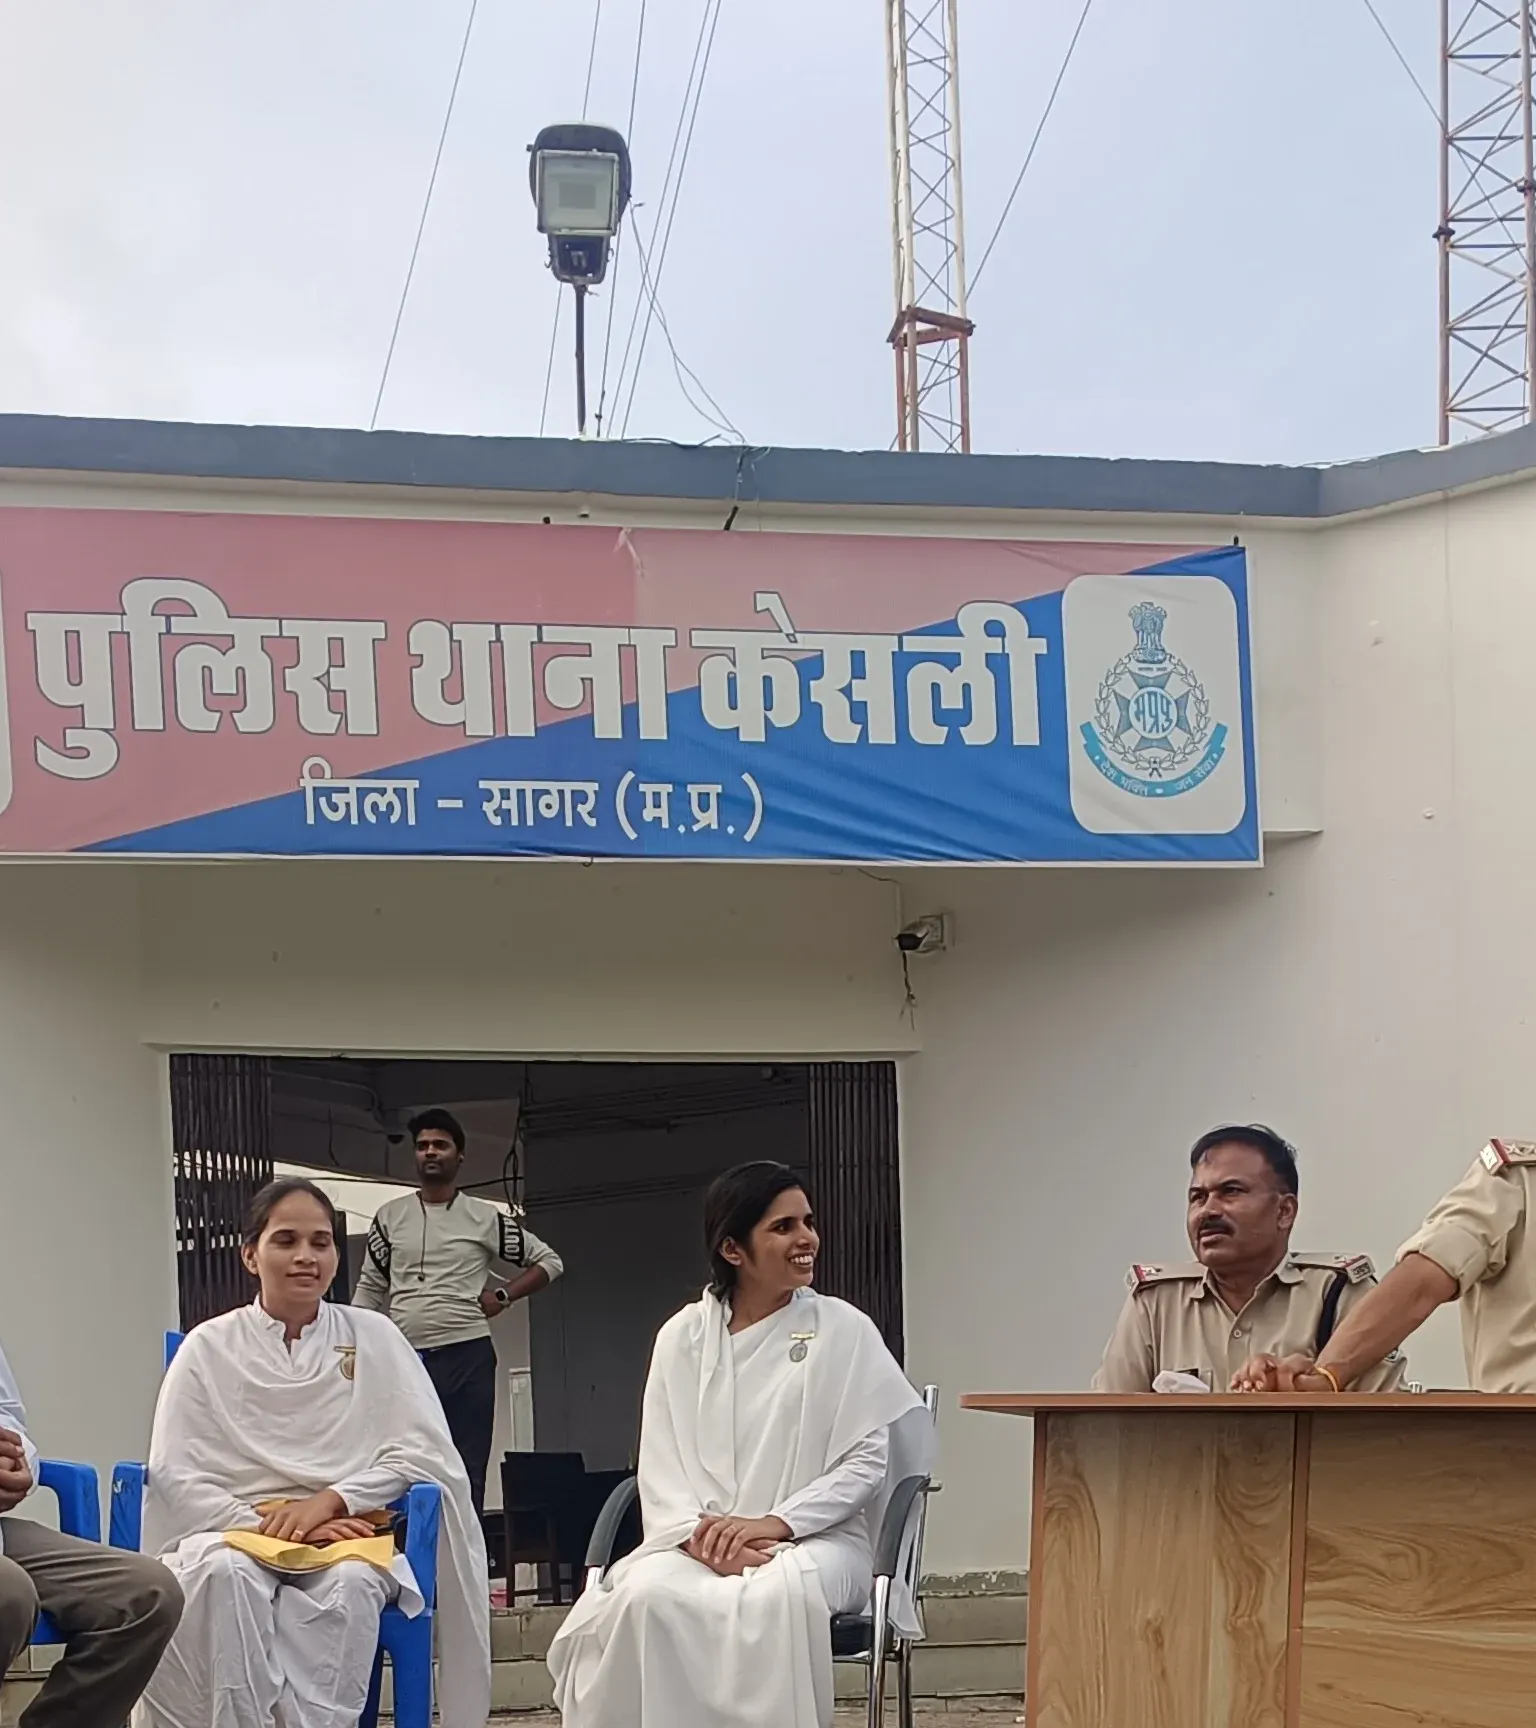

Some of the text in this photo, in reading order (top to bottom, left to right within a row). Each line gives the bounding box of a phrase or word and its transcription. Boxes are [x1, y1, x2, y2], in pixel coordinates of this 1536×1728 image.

[25, 576, 1048, 780] पुलिस थाना केसली
[299, 756, 420, 826] जिला
[478, 780, 600, 827] सागर
